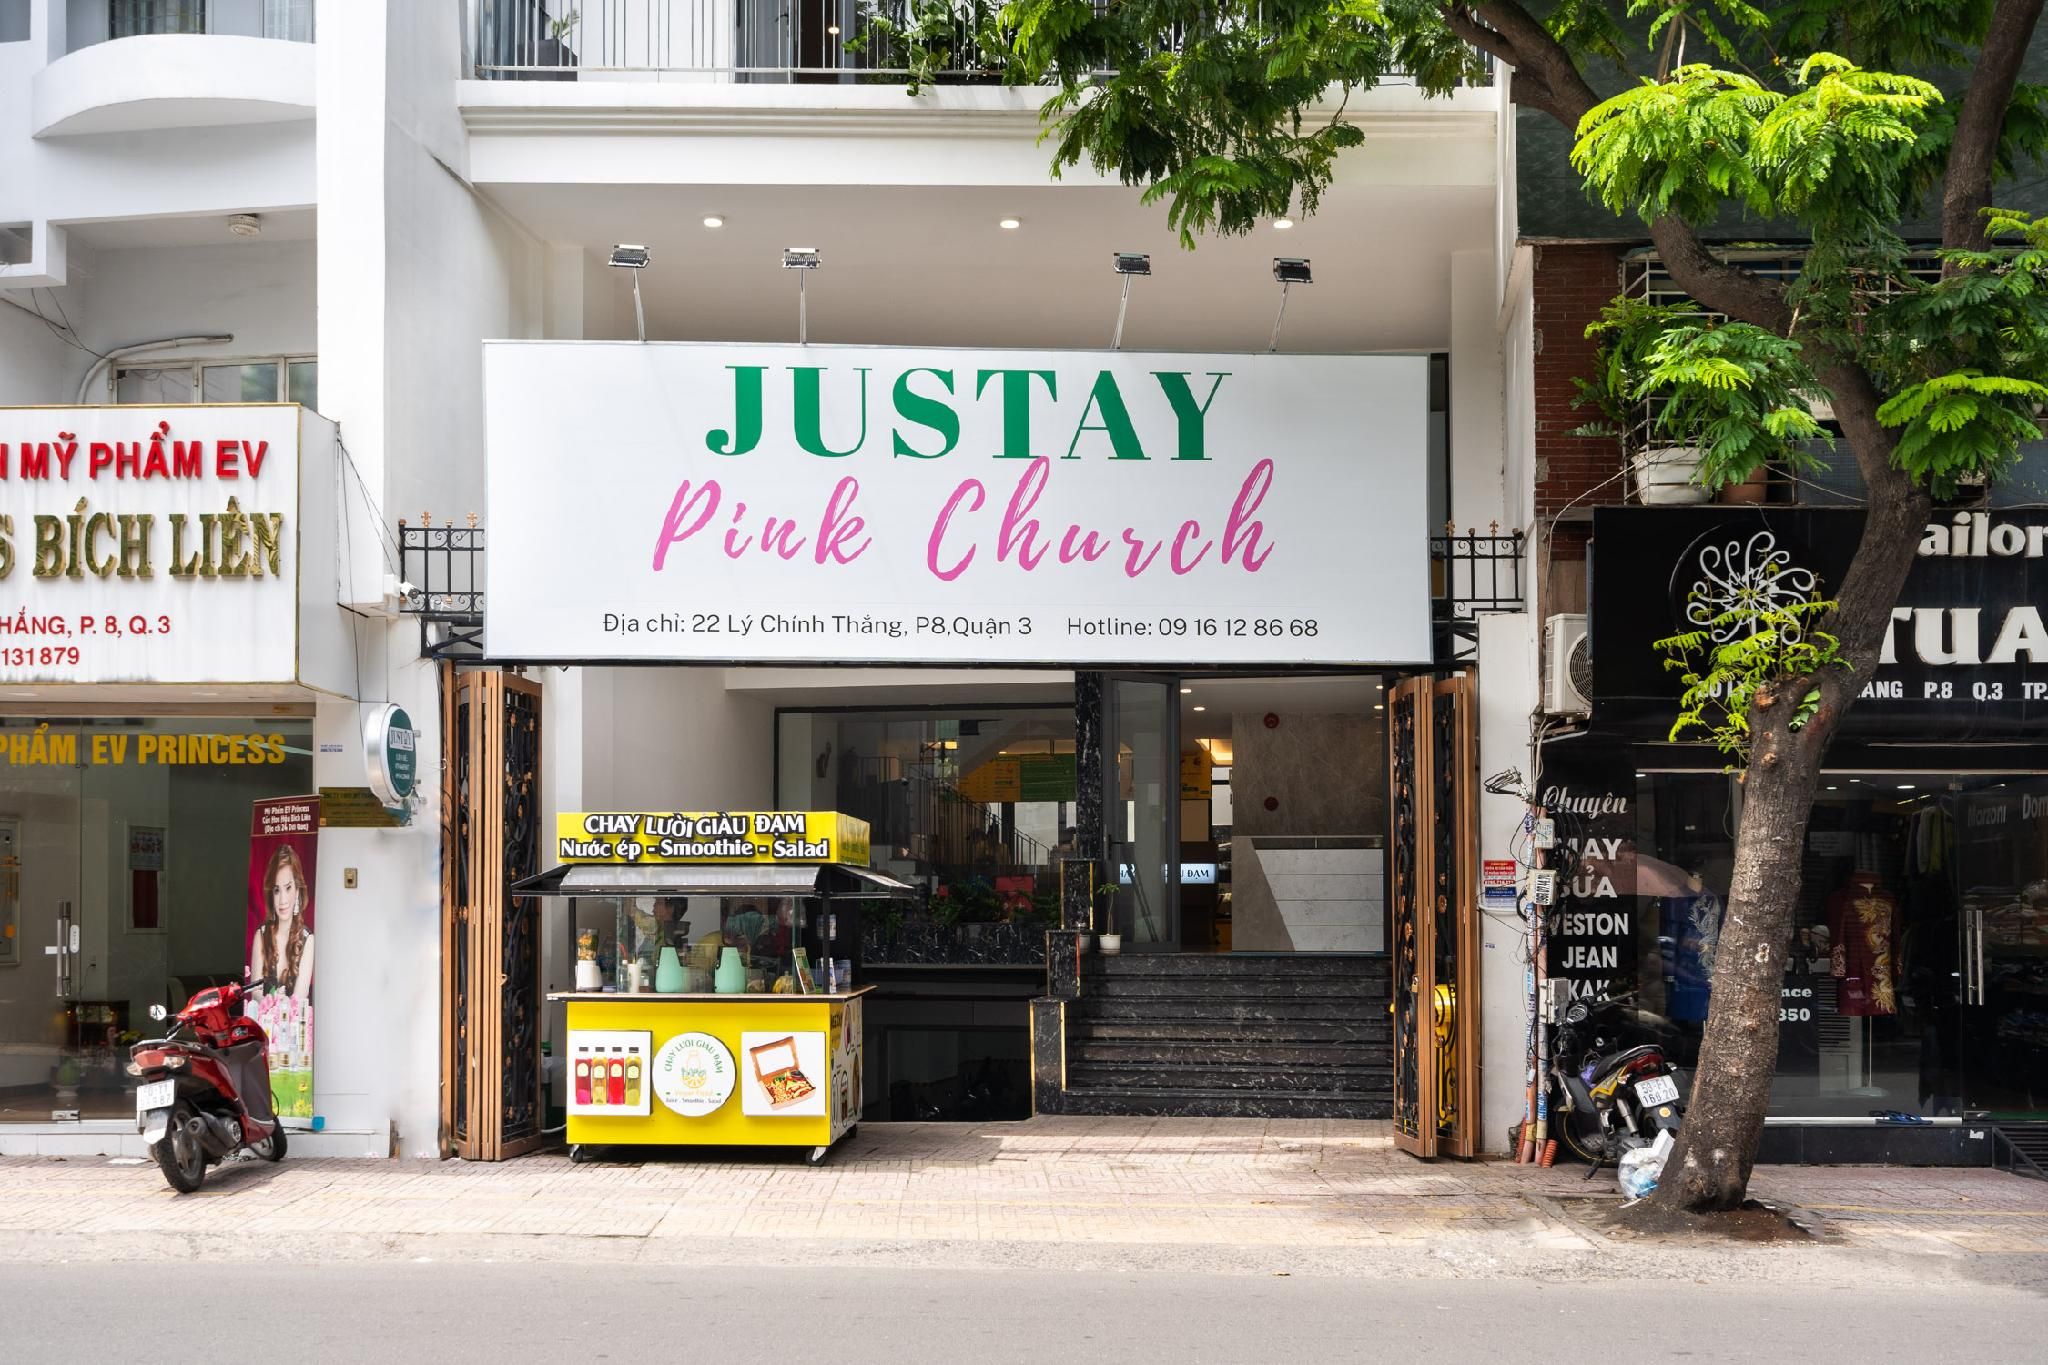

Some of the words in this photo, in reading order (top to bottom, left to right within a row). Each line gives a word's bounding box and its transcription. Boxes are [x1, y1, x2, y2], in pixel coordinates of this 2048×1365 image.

[705, 365, 1233, 461] JUSTAY
[20, 431, 79, 480] MỸ
[90, 420, 202, 480] PHẨM
[216, 440, 269, 480] EV
[653, 475, 873, 572] Pink
[927, 455, 1275, 582] Church
[33, 496, 156, 579] BÍCH
[168, 496, 284, 578] LIÊN
[158, 615, 171, 634] 3
[603, 613, 640, 636] Địa
[646, 612, 685, 633] chỉ:
[692, 614, 720, 633] 22
[728, 614, 754, 637] Lý
[761, 614, 825, 633] Chính
[832, 613, 909, 639] Thắng,
[1018, 616, 1032, 635] 3
[1068, 617, 1152, 637] Hotline:
[1857, 681, 1903, 698] ANG
[1924, 682, 1953, 699] P.8
[1972, 682, 2003, 701] Q.3
[92, 734, 128, 765] EV
[138, 734, 286, 765] PRINCESS
[1543, 785, 1628, 820] Chuyên
[584, 814, 641, 835] CHAY
[645, 813, 693, 839] LƯỜI
[696, 811, 747, 836] GIÀU
[755, 814, 805, 837] ĐẠM
[560, 838, 612, 858] Nước
[616, 838, 642, 863] ép
[660, 838, 753, 858] Smoothie
[773, 840, 830, 859] Salad
[1562, 946, 1617, 968] JEAN
